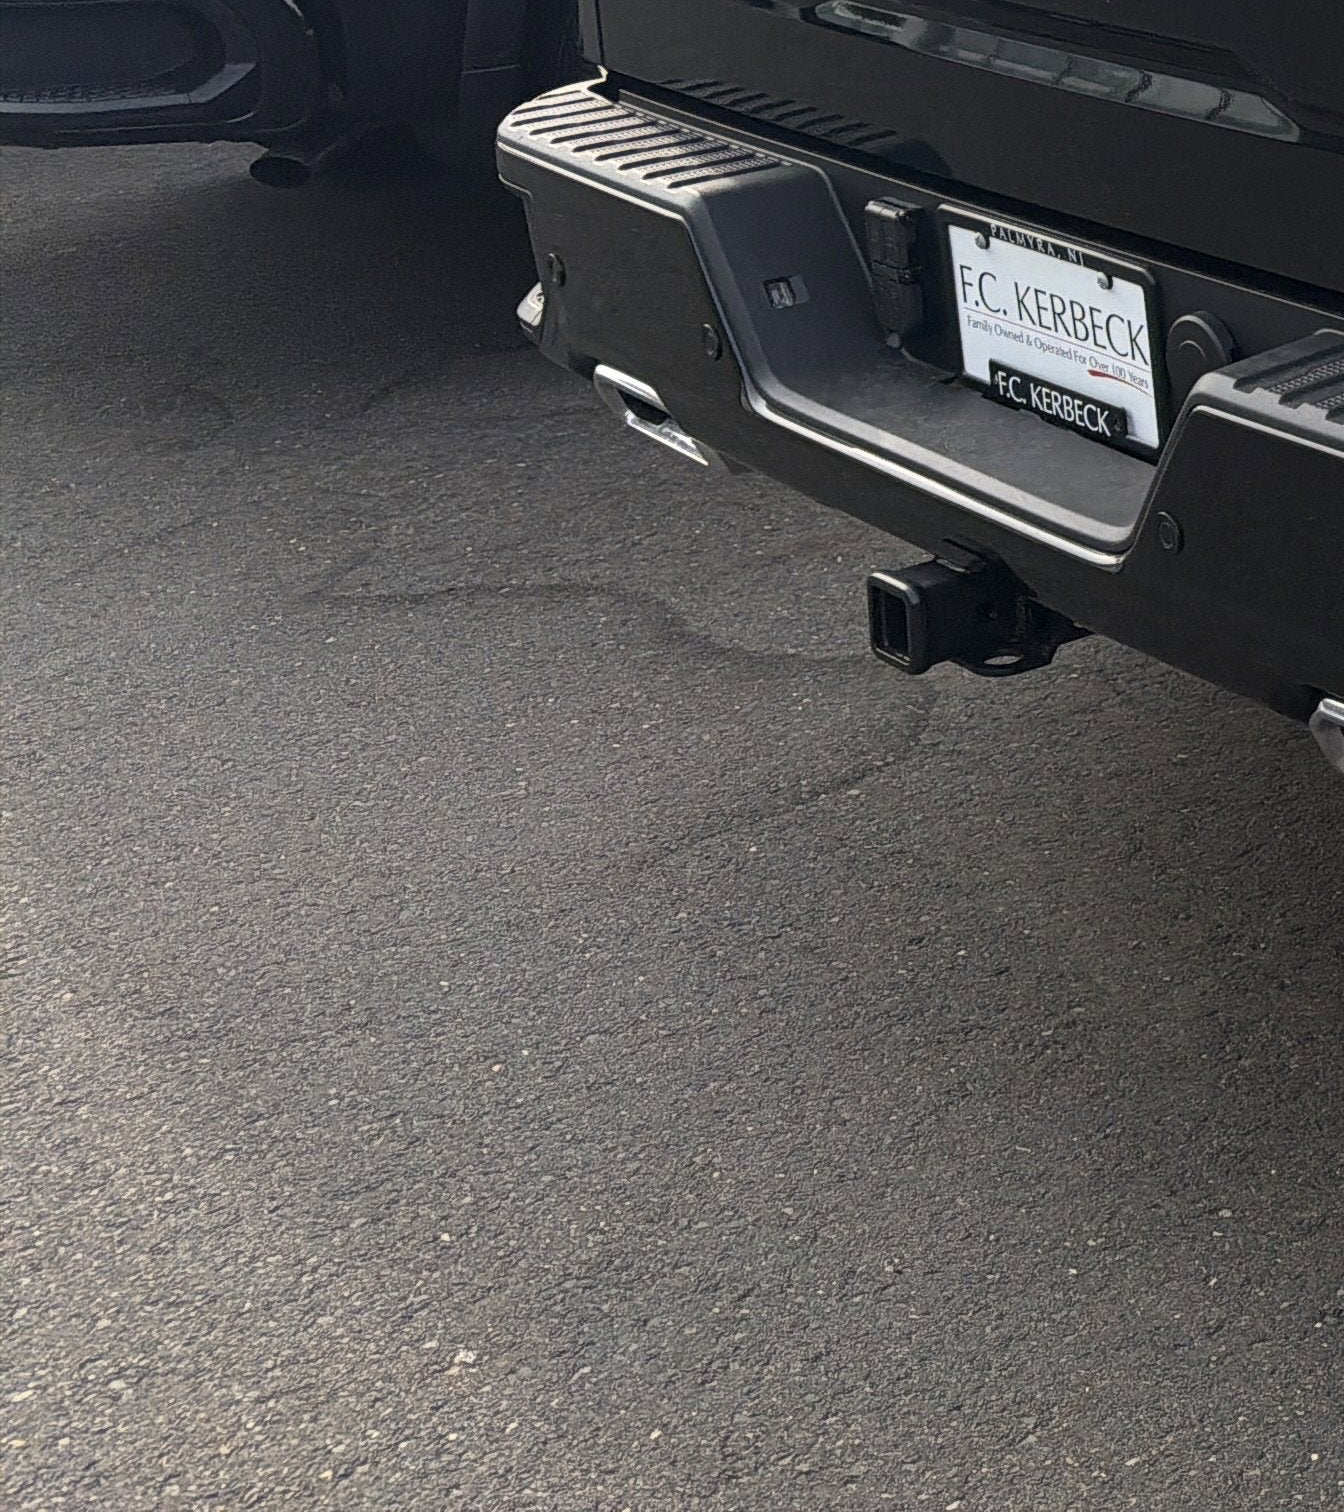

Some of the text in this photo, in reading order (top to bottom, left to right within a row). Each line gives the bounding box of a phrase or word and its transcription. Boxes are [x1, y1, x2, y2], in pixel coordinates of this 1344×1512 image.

[1067, 247, 1084, 266] NJ
[959, 264, 1149, 366] F.C. KERBECK
[967, 314, 1149, 390] Family Owned & Operated For Over 100 Years
[996, 371, 1112, 437] F.C. KERBECK
